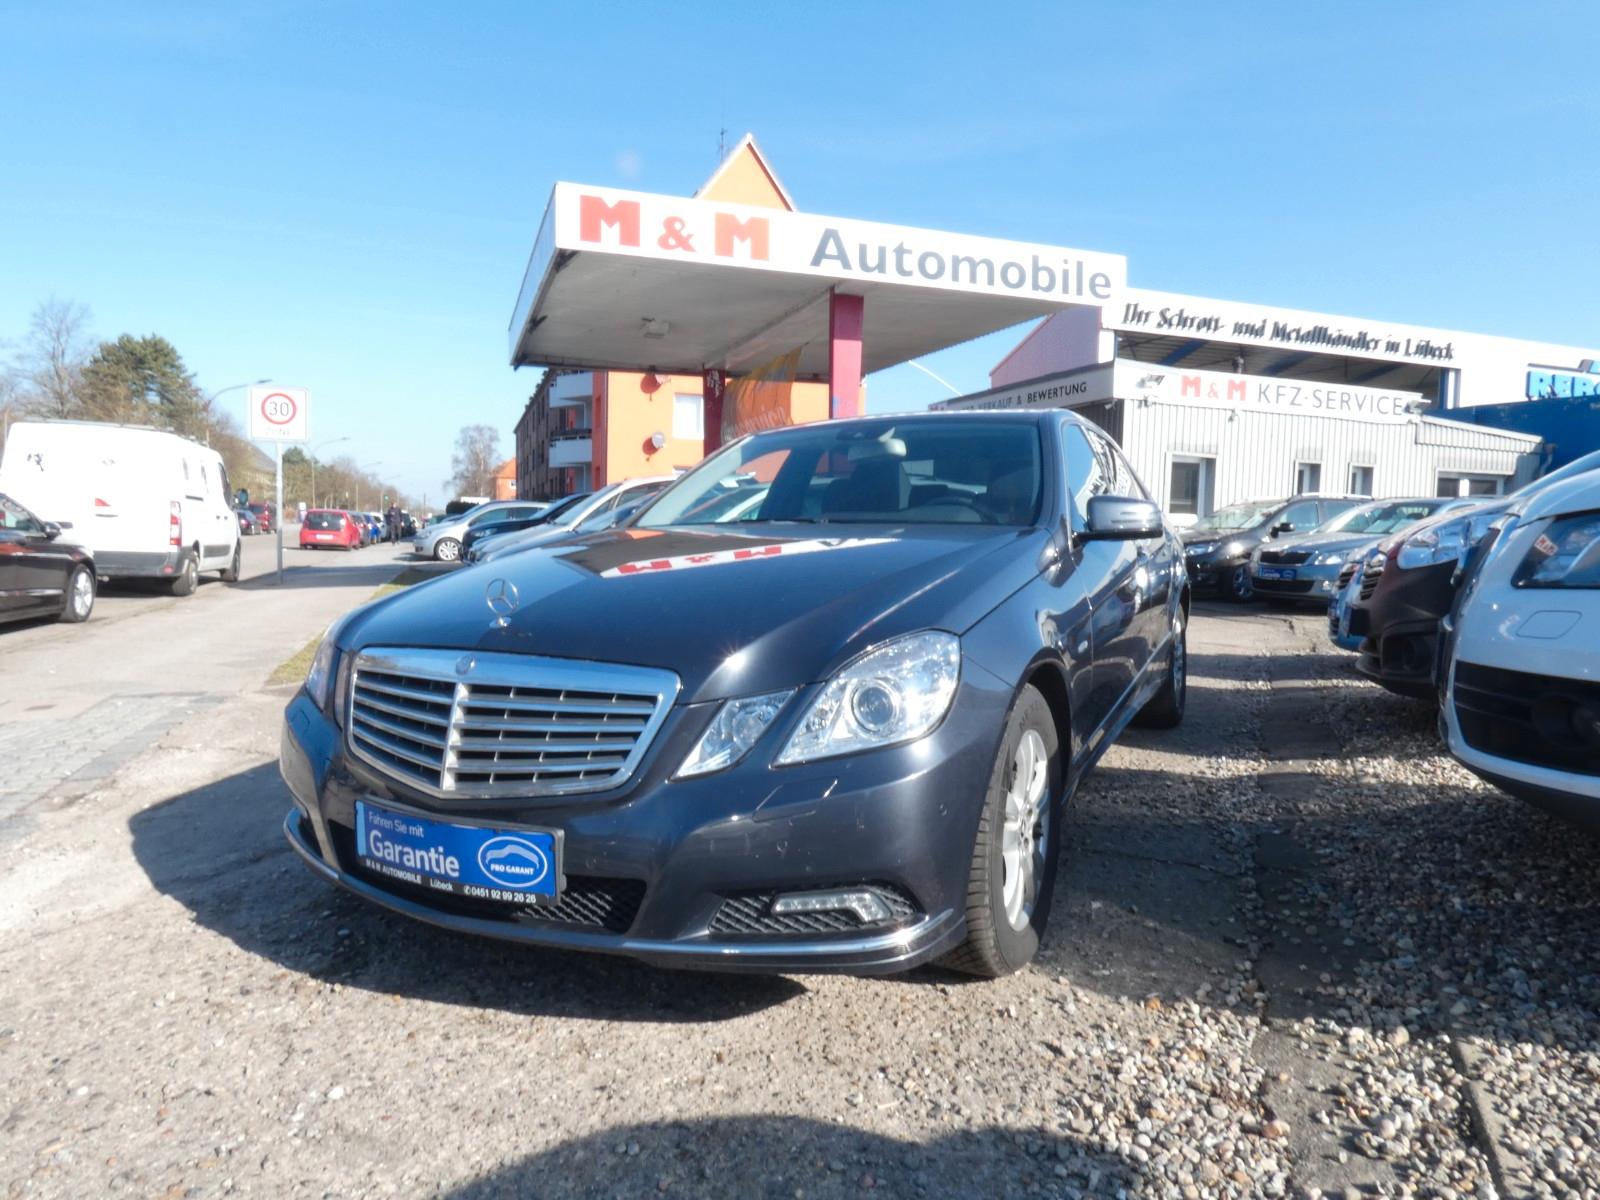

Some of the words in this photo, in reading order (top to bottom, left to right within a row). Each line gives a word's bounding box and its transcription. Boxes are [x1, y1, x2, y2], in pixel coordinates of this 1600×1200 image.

[580, 195, 640, 248] M
[657, 216, 695, 253] &
[715, 213, 769, 261] M
[811, 228, 1112, 299] Automobile
[1122, 303, 1153, 325] Ihr
[1232, 318, 1267, 337] und
[1270, 321, 1381, 352] Metallhändler
[1385, 334, 1400, 354] in
[1403, 338, 1454, 362] Lübeck
[1027, 382, 1087, 404] BEWERTUNG
[1181, 375, 1201, 397] M
[1208, 382, 1219, 398] &
[1227, 379, 1247, 401] M
[269, 400, 289, 416] 30
[369, 811, 393, 829] Fahren
[394, 819, 407, 834] Sie
[409, 824, 424, 838] mit
[370, 829, 459, 877] Garantie
[382, 865, 422, 884] AUTOMOBILE
[430, 878, 453, 891] Lübeck
[490, 863, 505, 873] PRO
[506, 865, 534, 876] GARANT
[491, 889, 501, 900] 92
